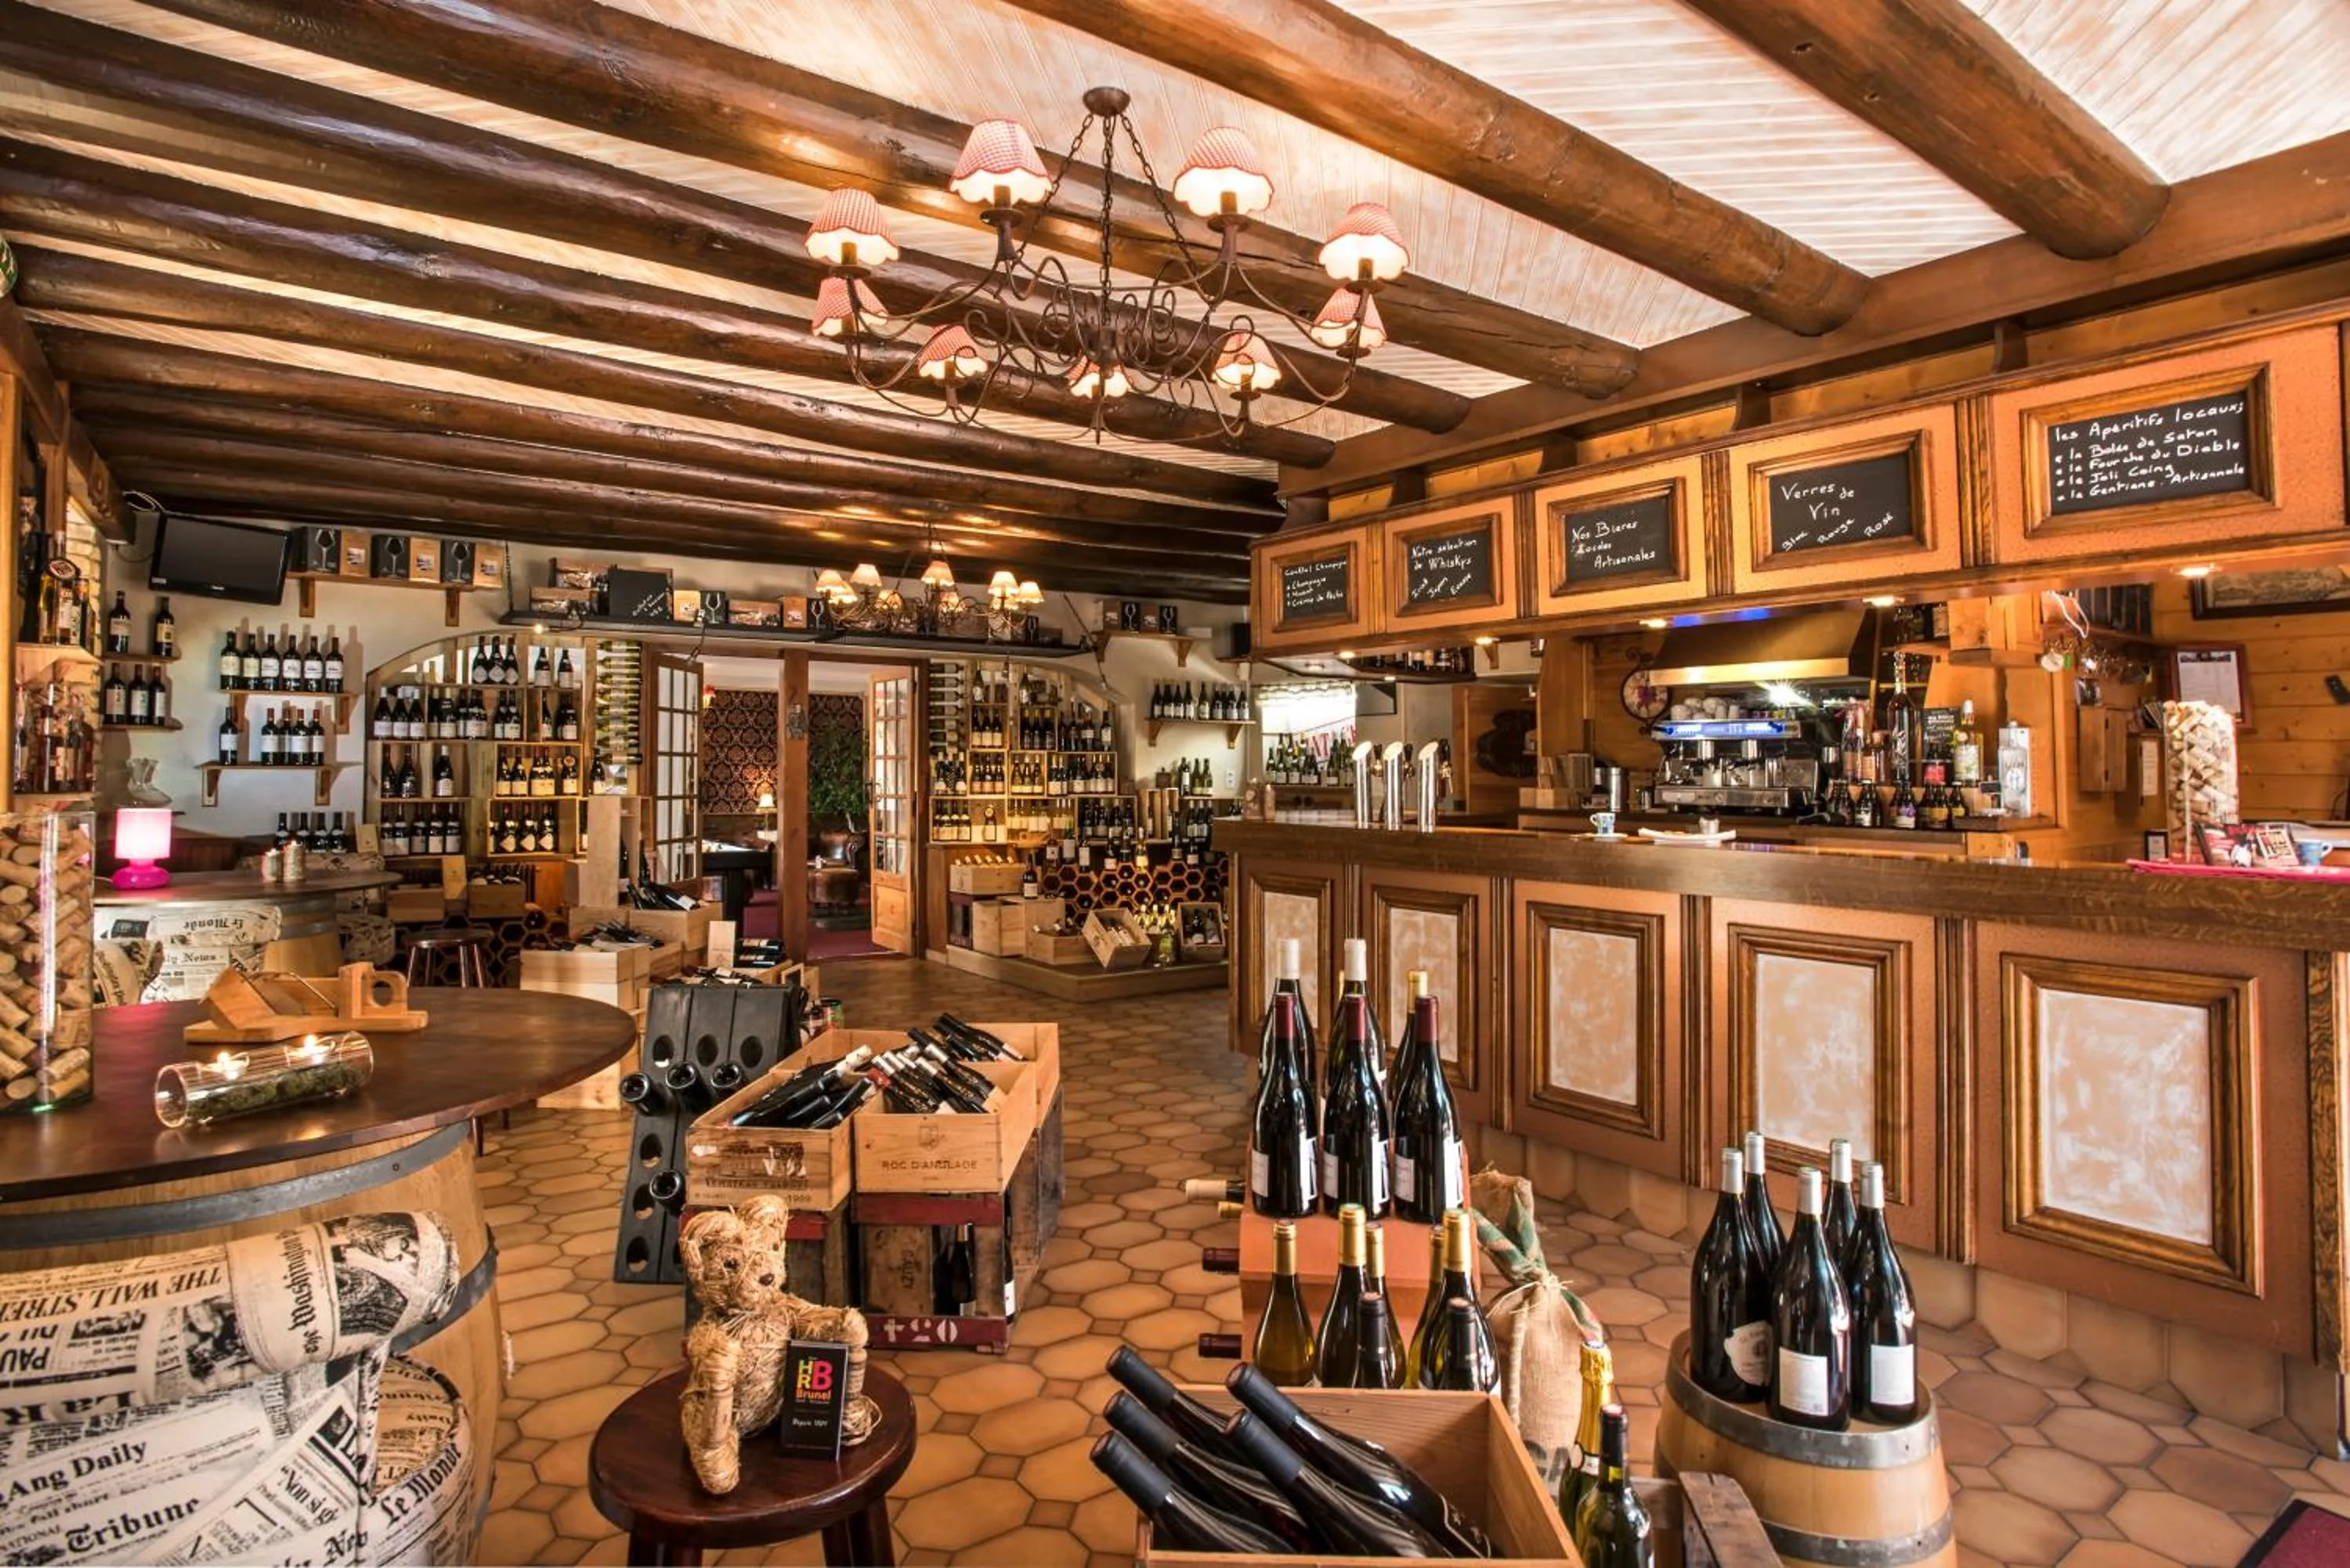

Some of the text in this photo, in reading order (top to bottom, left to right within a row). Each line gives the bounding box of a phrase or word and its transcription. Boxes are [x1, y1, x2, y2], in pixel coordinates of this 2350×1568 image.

[2055, 425, 2079, 443] les
[2138, 436, 2155, 450] de
[2163, 425, 2218, 446] Satan
[2150, 448, 2171, 461] du
[2177, 438, 2241, 457] Diable
[2089, 469, 2118, 486] Joli
[2089, 479, 2155, 498] Gentiane
[1781, 482, 1855, 501] Verres de
[1809, 502, 1841, 521] Vin
[1571, 526, 1591, 544] Nos
[1817, 517, 1856, 544] Rouge
[166, 1266, 222, 1295] THE
[89, 1279, 159, 1309] WALL
[70, 1441, 147, 1479] Daily
[65, 1497, 201, 1554] Tribune
